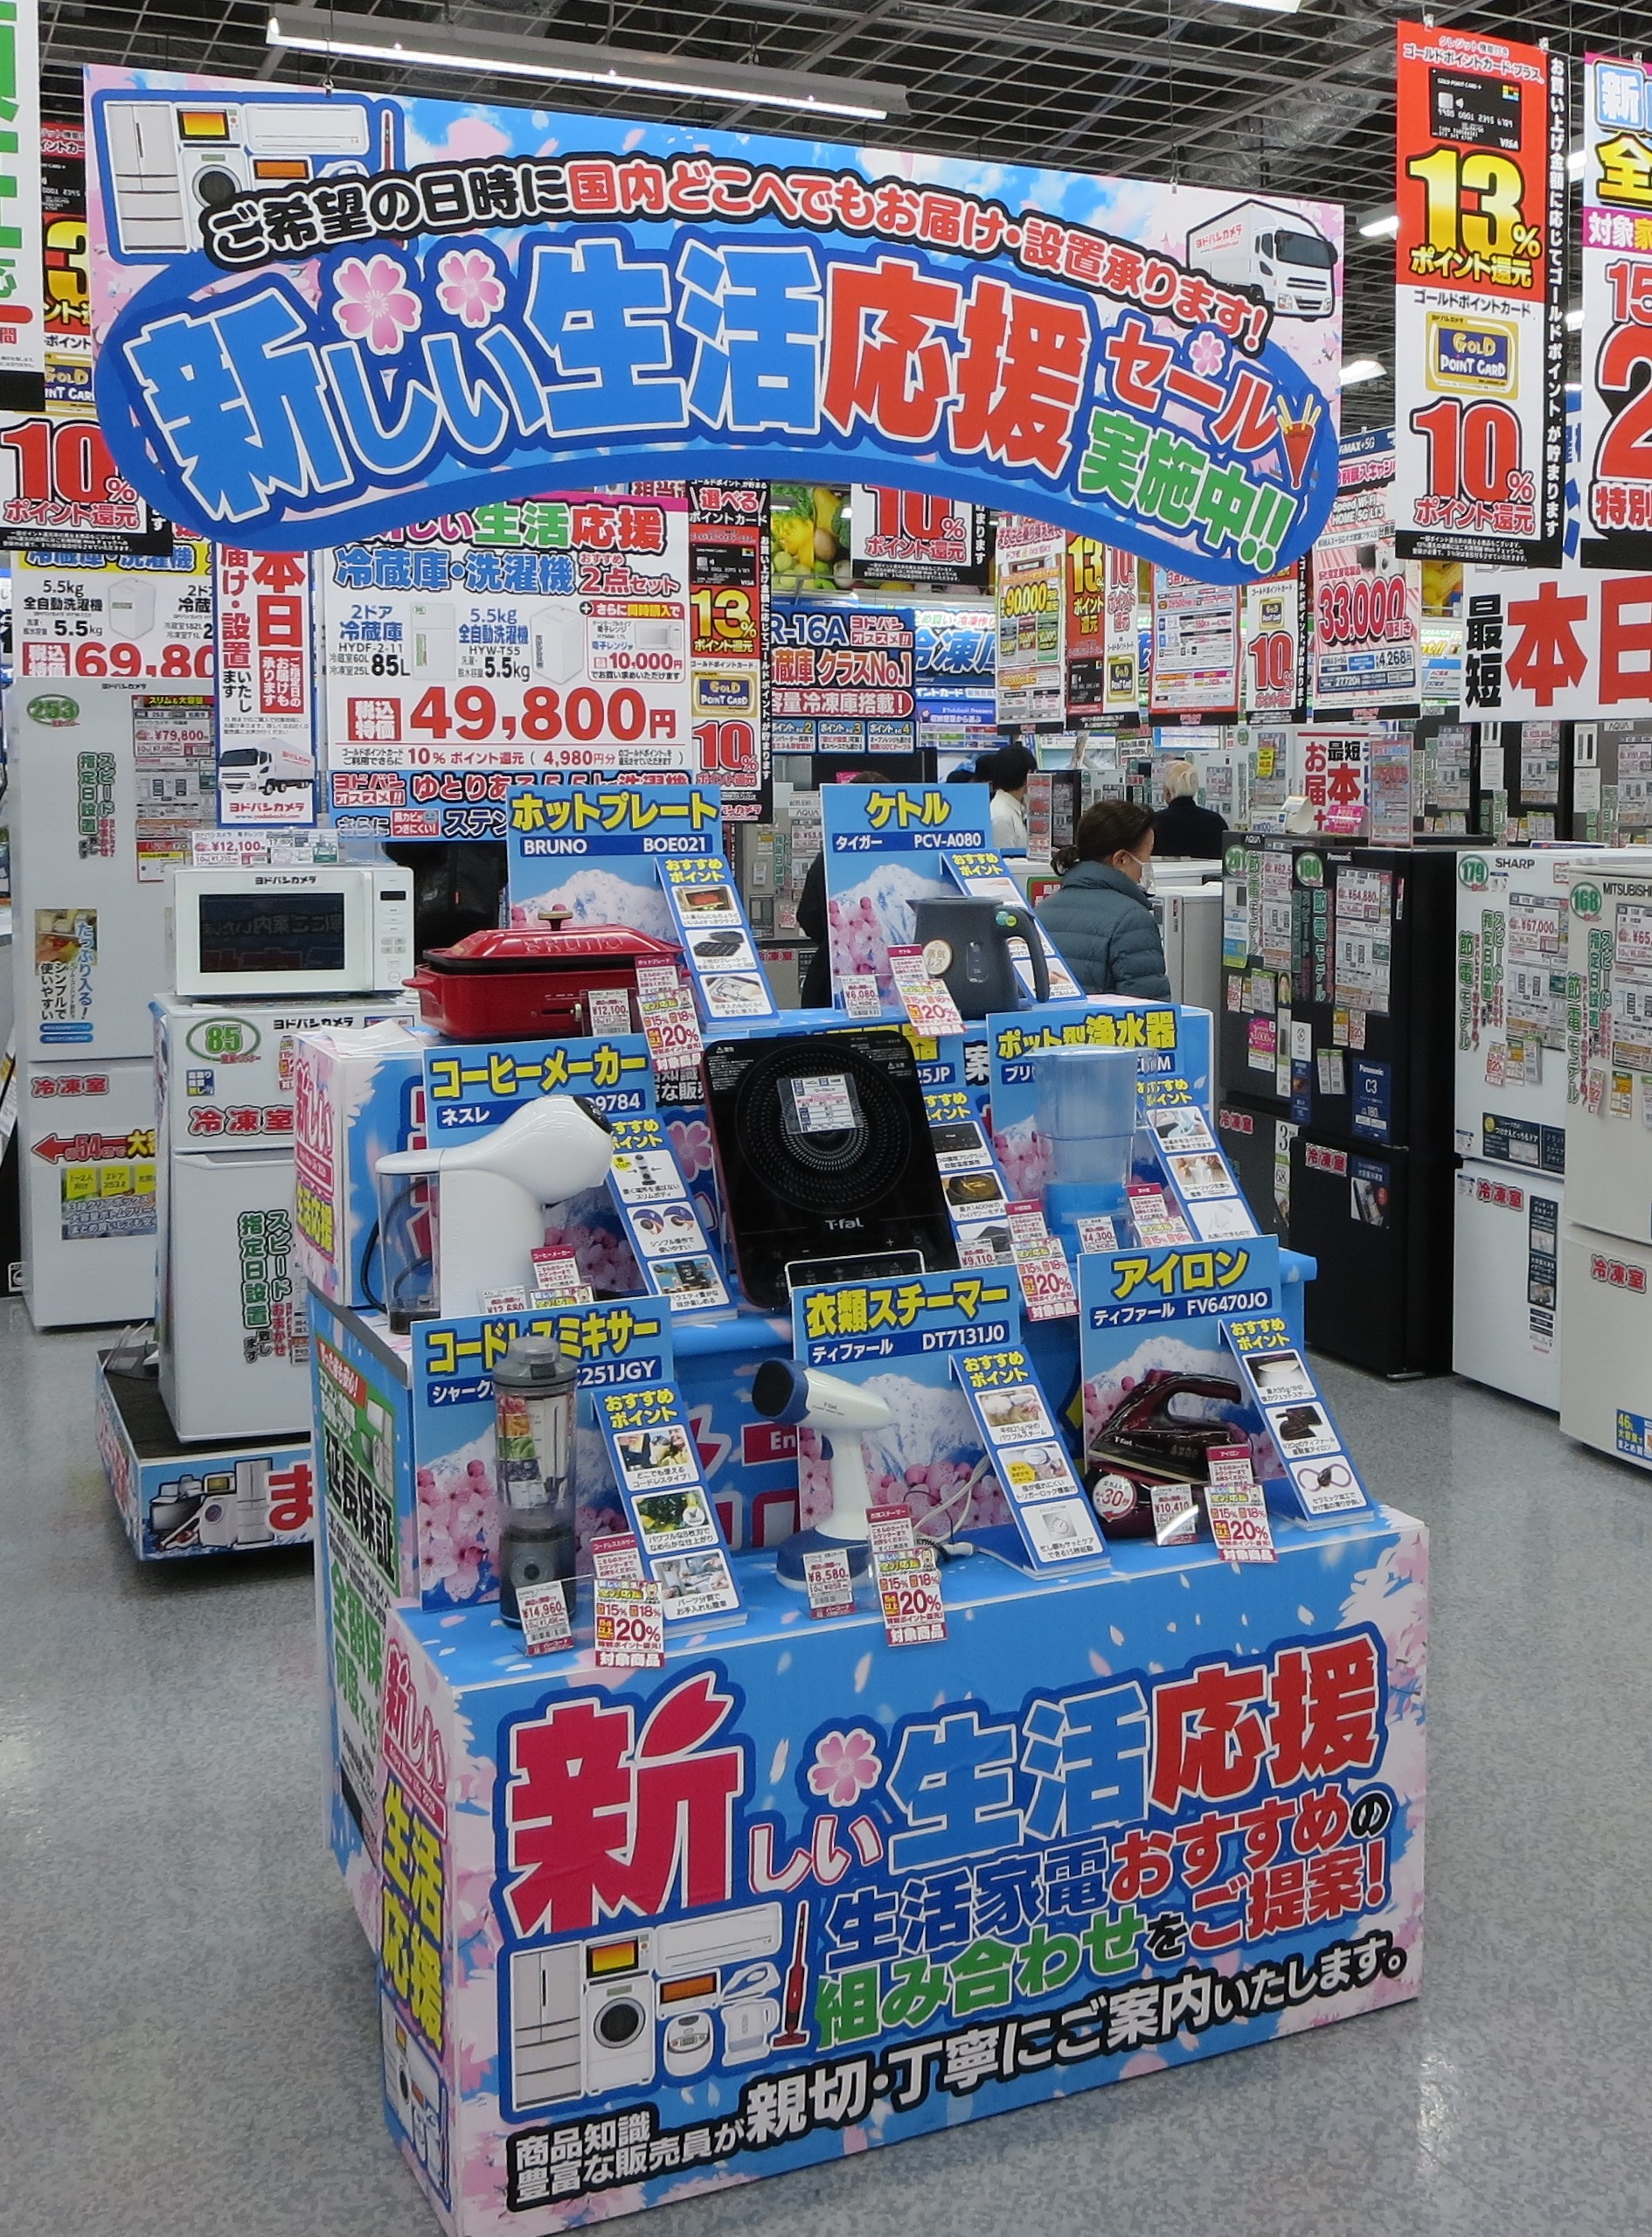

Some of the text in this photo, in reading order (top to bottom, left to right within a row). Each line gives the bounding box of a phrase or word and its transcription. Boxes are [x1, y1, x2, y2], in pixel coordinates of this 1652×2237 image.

[1601, 71, 1639, 121] 新
[1499, 137, 1519, 149] VISA
[1596, 133, 1652, 206] 全
[1407, 145, 1541, 257] 13%
[210, 157, 1267, 351] ご希望の日時に国内どこへでもお届け・設置承ります!
[1410, 244, 1533, 288] ポイント還元
[1413, 289, 1531, 316] ゴールドポイントカード
[1477, 362, 1506, 378] CARD
[1107, 320, 1280, 453] セール
[1409, 397, 1535, 502] 10%
[700, 489, 759, 511] 選べる
[1078, 407, 1295, 575] 実施中!!
[3, 499, 140, 530] ポイント還元
[690, 512, 767, 525] ポイントカード
[1414, 497, 1535, 533] ポイント還元
[357, 500, 667, 553] しい生活応援
[864, 536, 967, 561] ポイント還元
[580, 553, 625, 566] おすすめ
[335, 546, 575, 595] 冷蔵庫・洗濯機
[43, 580, 85, 598] 5.5kg
[580, 566, 679, 597] 2点セット
[23, 596, 103, 612] 全自動洗濯機
[253, 552, 306, 647] 本日
[351, 604, 393, 620] 2ドア
[470, 608, 517, 625] 5.5kg
[691, 587, 758, 639] 13%
[850, 615, 904, 630] ヨドバシ
[53, 619, 103, 638] 5.5kg
[339, 622, 403, 643] 冷蔵庫
[458, 625, 529, 645] 全自動洗濯機
[338, 643, 403, 654] HYDF-2-11
[469, 646, 521, 657] HYW-T55
[694, 639, 753, 654] ポイント還元
[1465, 575, 1652, 708] 最短 本日
[371, 655, 411, 677] 85L
[484, 657, 531, 682] 5.5kg
[609, 652, 682, 670] 10,000円
[817, 650, 912, 687] クラスNo.1
[592, 670, 681, 680] でお買い求めいただけます
[355, 701, 395, 718] 税込
[410, 685, 677, 741] 49,800円
[155, 730, 205, 742] ¥79,800
[355, 719, 396, 740] 特価
[692, 719, 759, 771] 10%
[1328, 740, 1361, 761] 最短
[451, 751, 524, 766] ポイント還元
[333, 773, 406, 790] ヨドバシ
[696, 773, 758, 787] ポイント還元
[229, 802, 305, 813] ヨドバシカメラ
[510, 791, 718, 832] ホットプレート
[865, 790, 951, 829] ケトル
[212, 841, 261, 852] ¥12,100
[524, 836, 706, 855] BRUNO BOE021
[836, 832, 982, 851] タイガー PCV-A080
[1245, 836, 1263, 844] AQUA
[665, 858, 723, 872] おすすめ
[951, 852, 999, 865] おすすめ
[1495, 858, 1535, 869] SHARP
[255, 876, 316, 886] ヨドバシカメラ
[670, 871, 725, 884] ポイント
[959, 865, 1004, 877] ポイント
[1462, 861, 1484, 883] 179
[1575, 888, 1598, 908] 168
[77, 922, 93, 1021] たっぷり入る!
[40, 963, 53, 1021] 使いやすい
[54, 963, 67, 1020] シンプルで
[593, 1005, 627, 1016] ¥12,100
[922, 1004, 957, 1018] 20%
[273, 1017, 353, 1031] ヨドバシカメラ
[205, 1025, 243, 1055] 85
[662, 1025, 699, 1046] 20%
[431, 1044, 648, 1100] コーヒーメーカー
[31, 1075, 108, 1097] 冷凍室
[188, 1106, 295, 1136] 冷凍室
[441, 1108, 489, 1127] ネスレ
[1219, 1109, 1253, 1135] 冷凍室
[1305, 1143, 1348, 1178] 冷凍室
[1477, 1178, 1524, 1212] 冷凍室
[825, 1218, 864, 1231] T-fal
[1084, 1232, 1113, 1242] ¥4,300
[267, 1209, 293, 1303] スピード
[962, 1255, 992, 1266] ¥9,110
[237, 1211, 271, 1330] 指定日設置
[1113, 1249, 1250, 1299] アイロン
[1590, 1253, 1647, 1294] 冷凍室
[1036, 1274, 1072, 1295] 20%
[805, 1279, 1009, 1338] 衣類スチーマー
[1093, 1303, 1175, 1327] ティファール
[1231, 1318, 1287, 1337] おすすめ
[812, 1339, 893, 1365] ティファール
[1237, 1333, 1290, 1351] ポイント
[963, 1351, 1025, 1372] おすすめ
[969, 1367, 1029, 1388] ポイント
[604, 1388, 675, 1413] おすすめ
[610, 1406, 678, 1429] ポイント
[1218, 1507, 1238, 1518] 15%
[1230, 1519, 1267, 1540] 20%
[809, 1568, 846, 1583] ¥8,580
[888, 1574, 939, 1589] 15% 18%
[522, 1601, 563, 1619] ¥14,960
[606, 1604, 661, 1617] 15% 18%
[899, 1589, 941, 1615] 20%
[616, 1618, 661, 1643] 20%
[890, 1624, 944, 1643] 対象商品
[600, 1652, 661, 1667] 対象商品
[816, 1838, 1388, 2052] 組み合わせをご提案!
[516, 2111, 651, 2170] 商品知識
[516, 2119, 746, 2201] 豊富な販売員が
